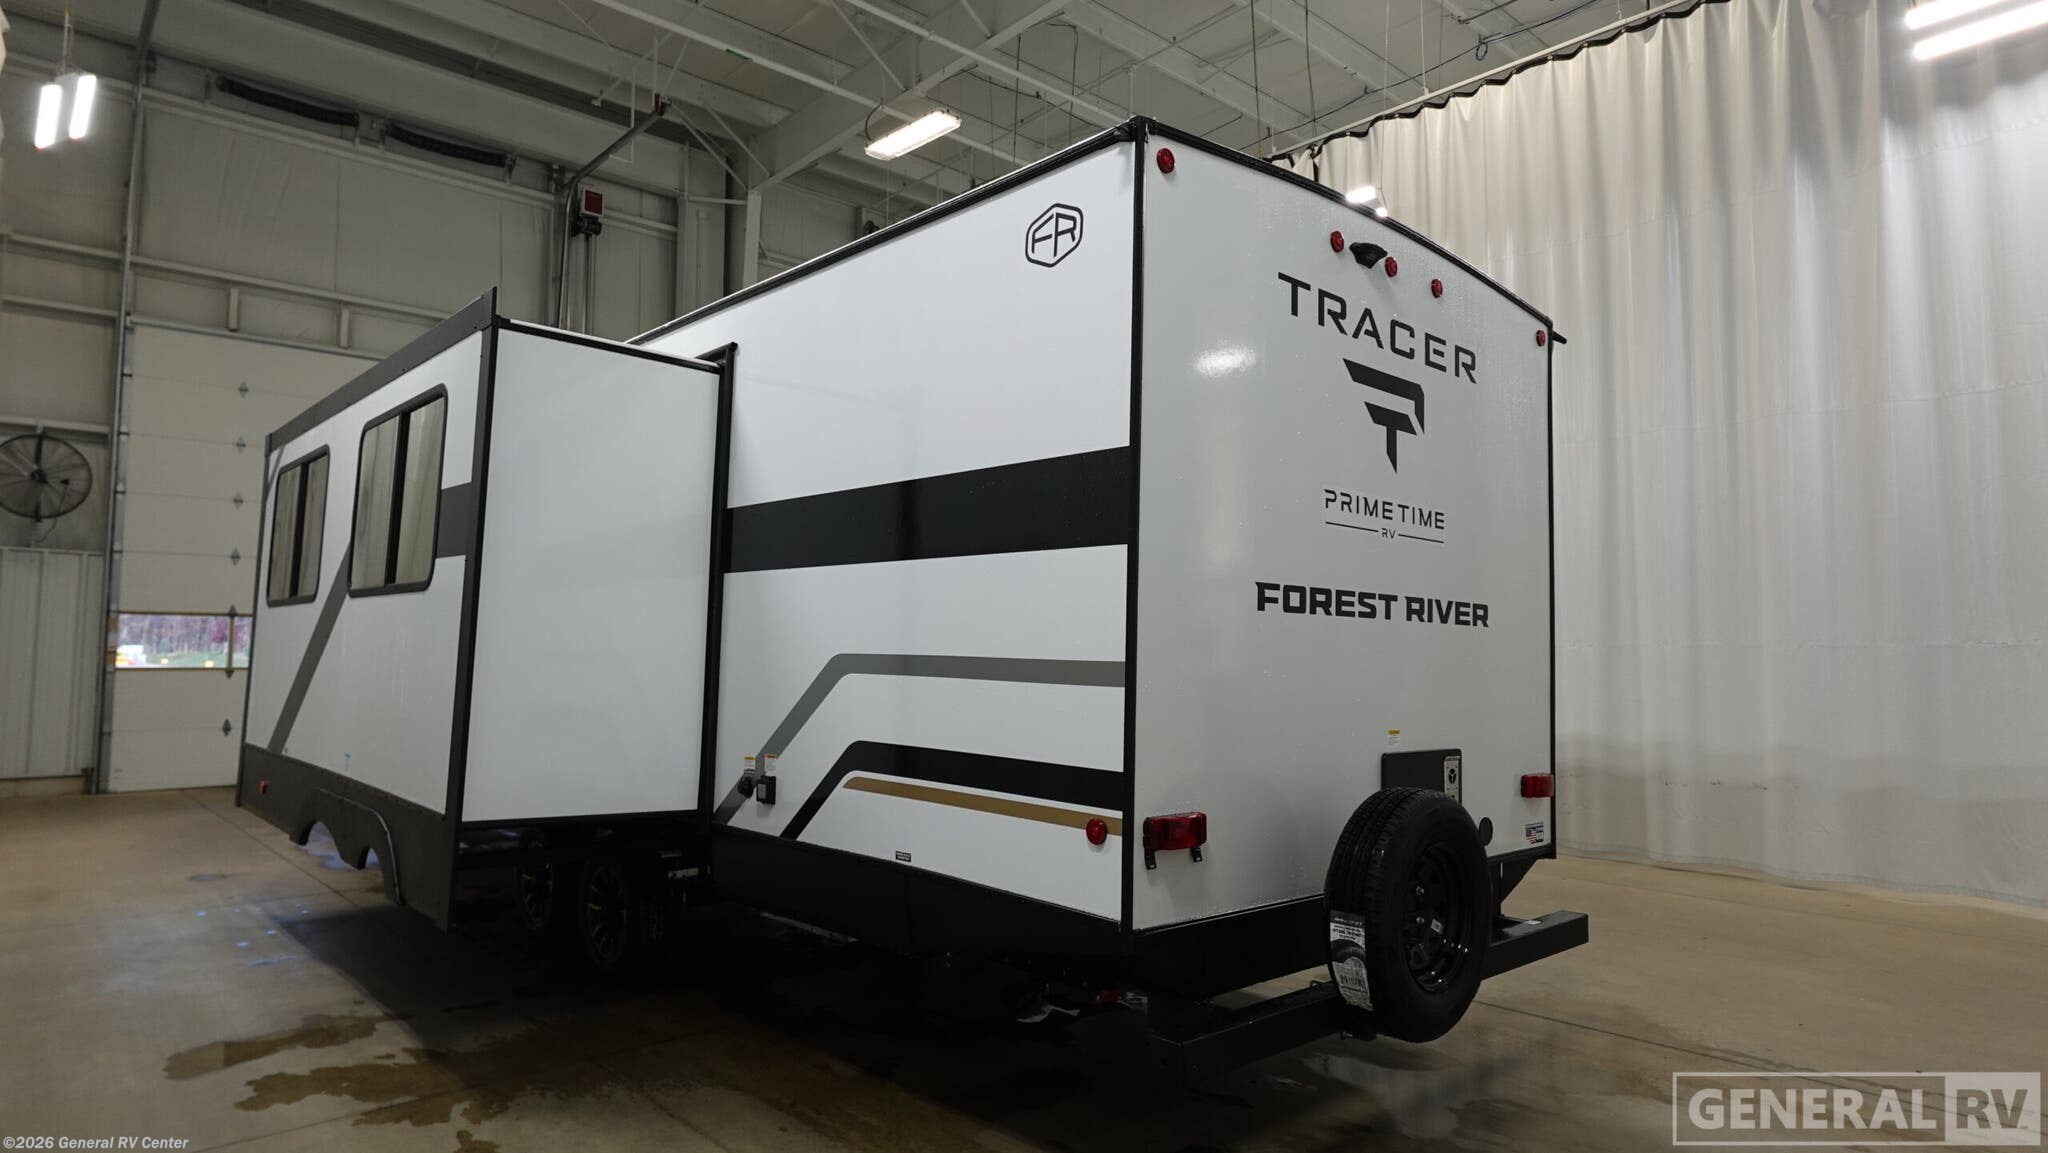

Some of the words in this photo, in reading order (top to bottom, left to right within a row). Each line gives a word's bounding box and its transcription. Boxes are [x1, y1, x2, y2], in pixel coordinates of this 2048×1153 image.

[1277, 271, 1477, 384] TRACER
[1381, 527, 1396, 540] RV
[1255, 581, 1398, 620] FOREST
[1404, 595, 1489, 628] RIVER
